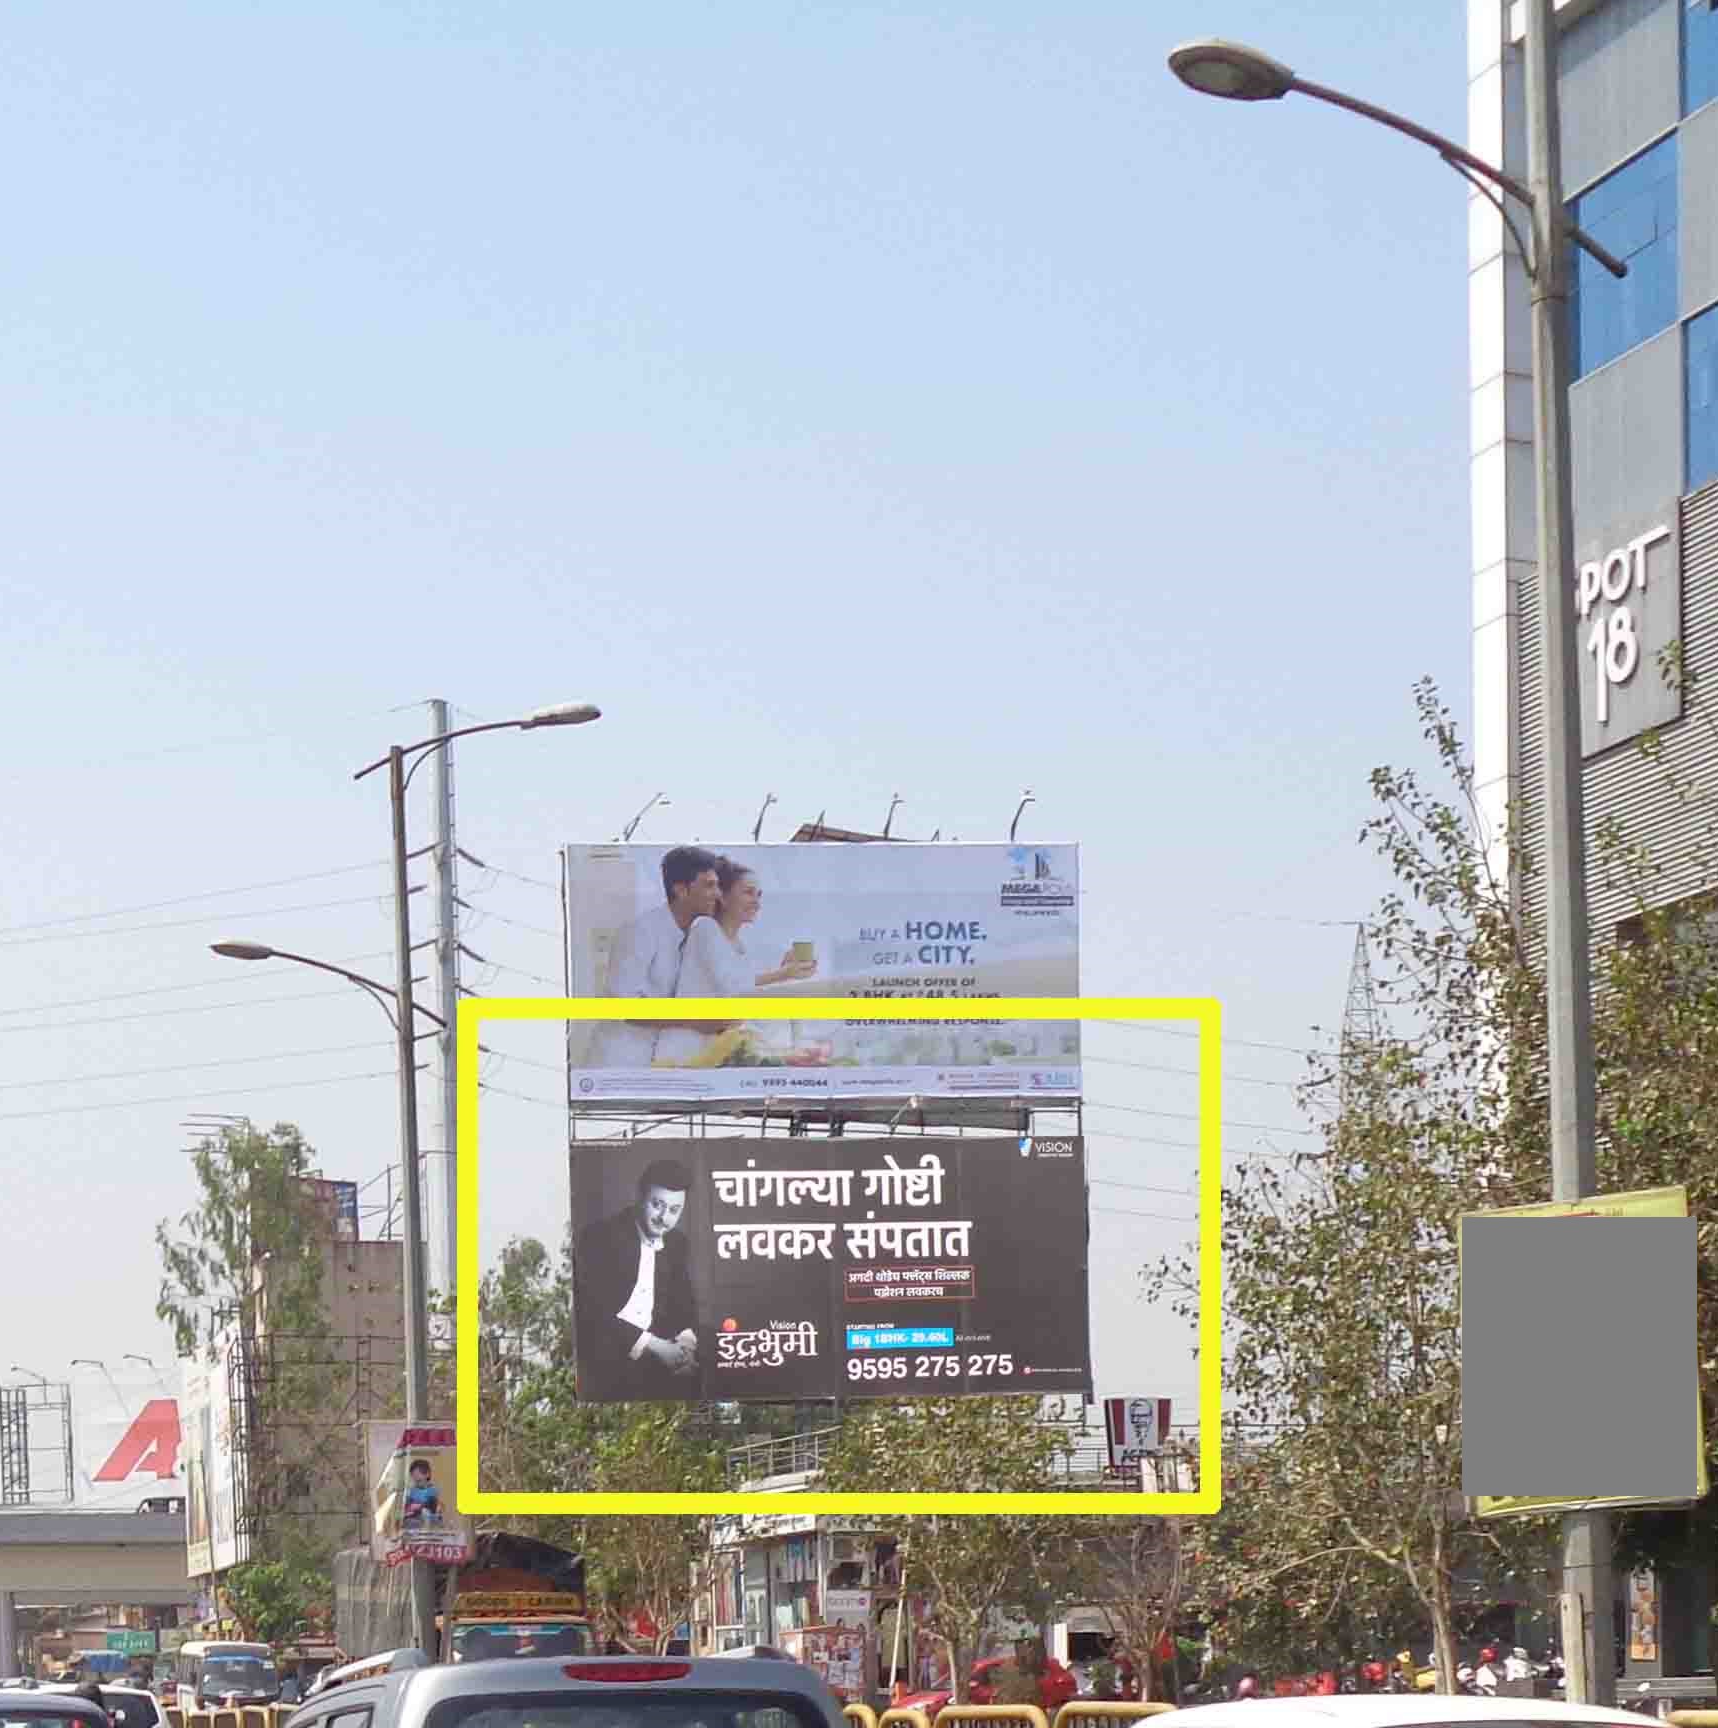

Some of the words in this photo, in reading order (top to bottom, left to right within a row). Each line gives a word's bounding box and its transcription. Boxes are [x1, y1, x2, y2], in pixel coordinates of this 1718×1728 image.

[1575, 525, 1670, 616] POT
[1587, 606, 1638, 722] 18
[906, 921, 987, 941] HOME.
[918, 945, 976, 965] CITY.
[712, 1158, 854, 1207] चांगल्या
[861, 1153, 945, 1206] गोष्टी
[713, 1223, 836, 1260] लवकर
[843, 1210, 973, 1259] संपतात
[847, 1357, 908, 1381] 9595
[915, 1356, 960, 1378] 275
[968, 1354, 1014, 1377] 275
